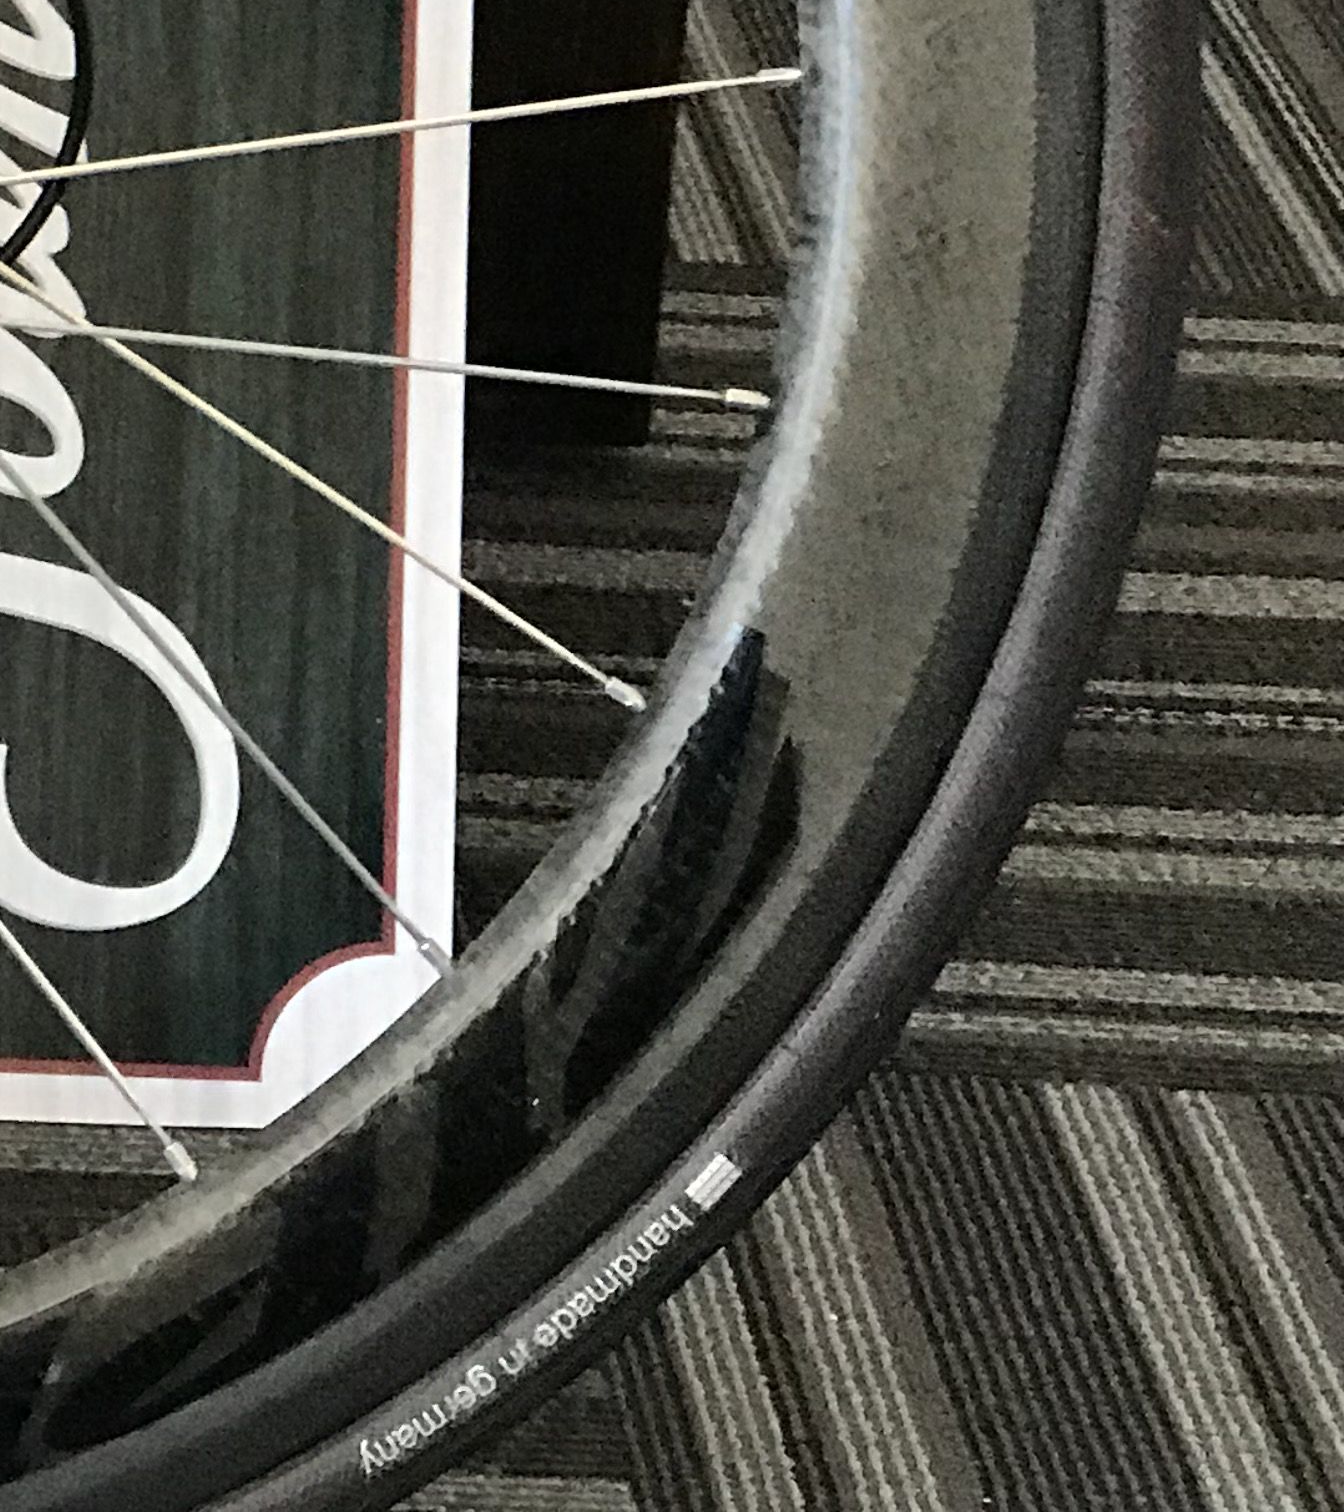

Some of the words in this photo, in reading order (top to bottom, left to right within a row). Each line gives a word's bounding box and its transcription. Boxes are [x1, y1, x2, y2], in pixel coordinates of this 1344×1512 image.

[533, 1204, 694, 1348] handmade
[498, 1336, 530, 1376] in
[359, 1364, 497, 1476] germany
